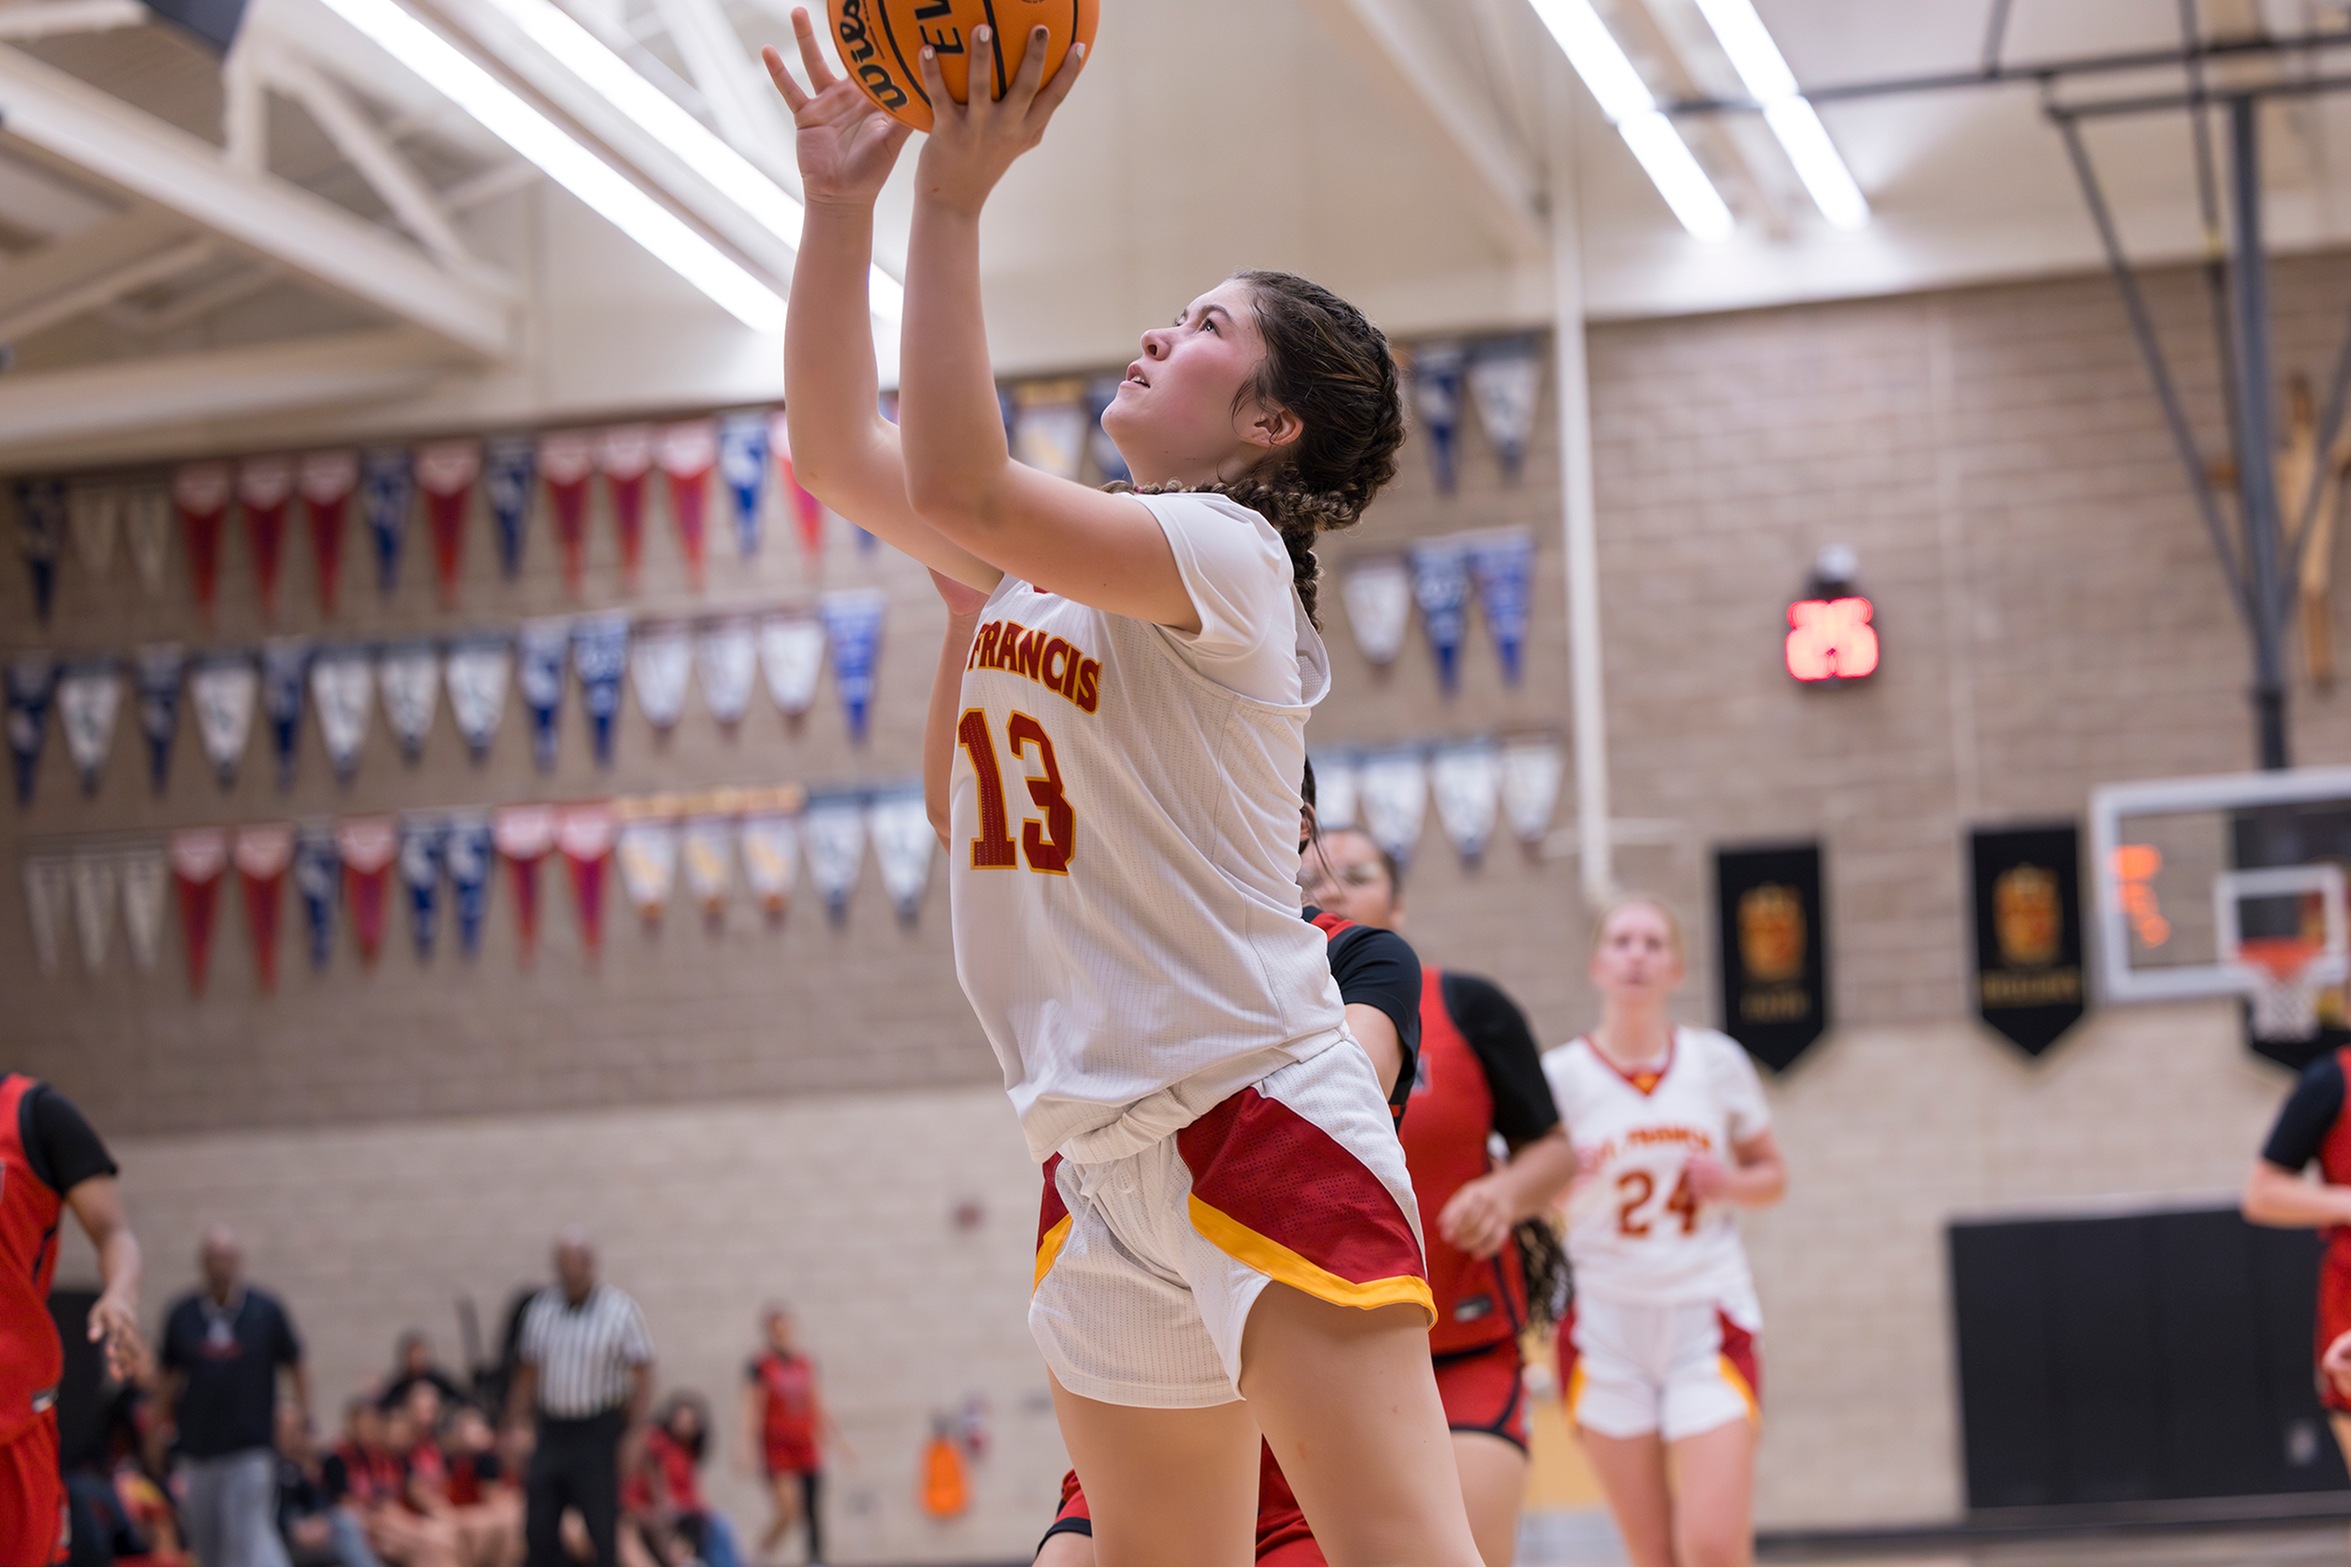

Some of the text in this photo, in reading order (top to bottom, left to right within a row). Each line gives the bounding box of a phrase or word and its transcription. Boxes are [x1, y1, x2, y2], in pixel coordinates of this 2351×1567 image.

[967, 619, 1102, 715] FRANCIS
[958, 708, 1076, 877] 13
[1616, 1167, 1698, 1238] 24
